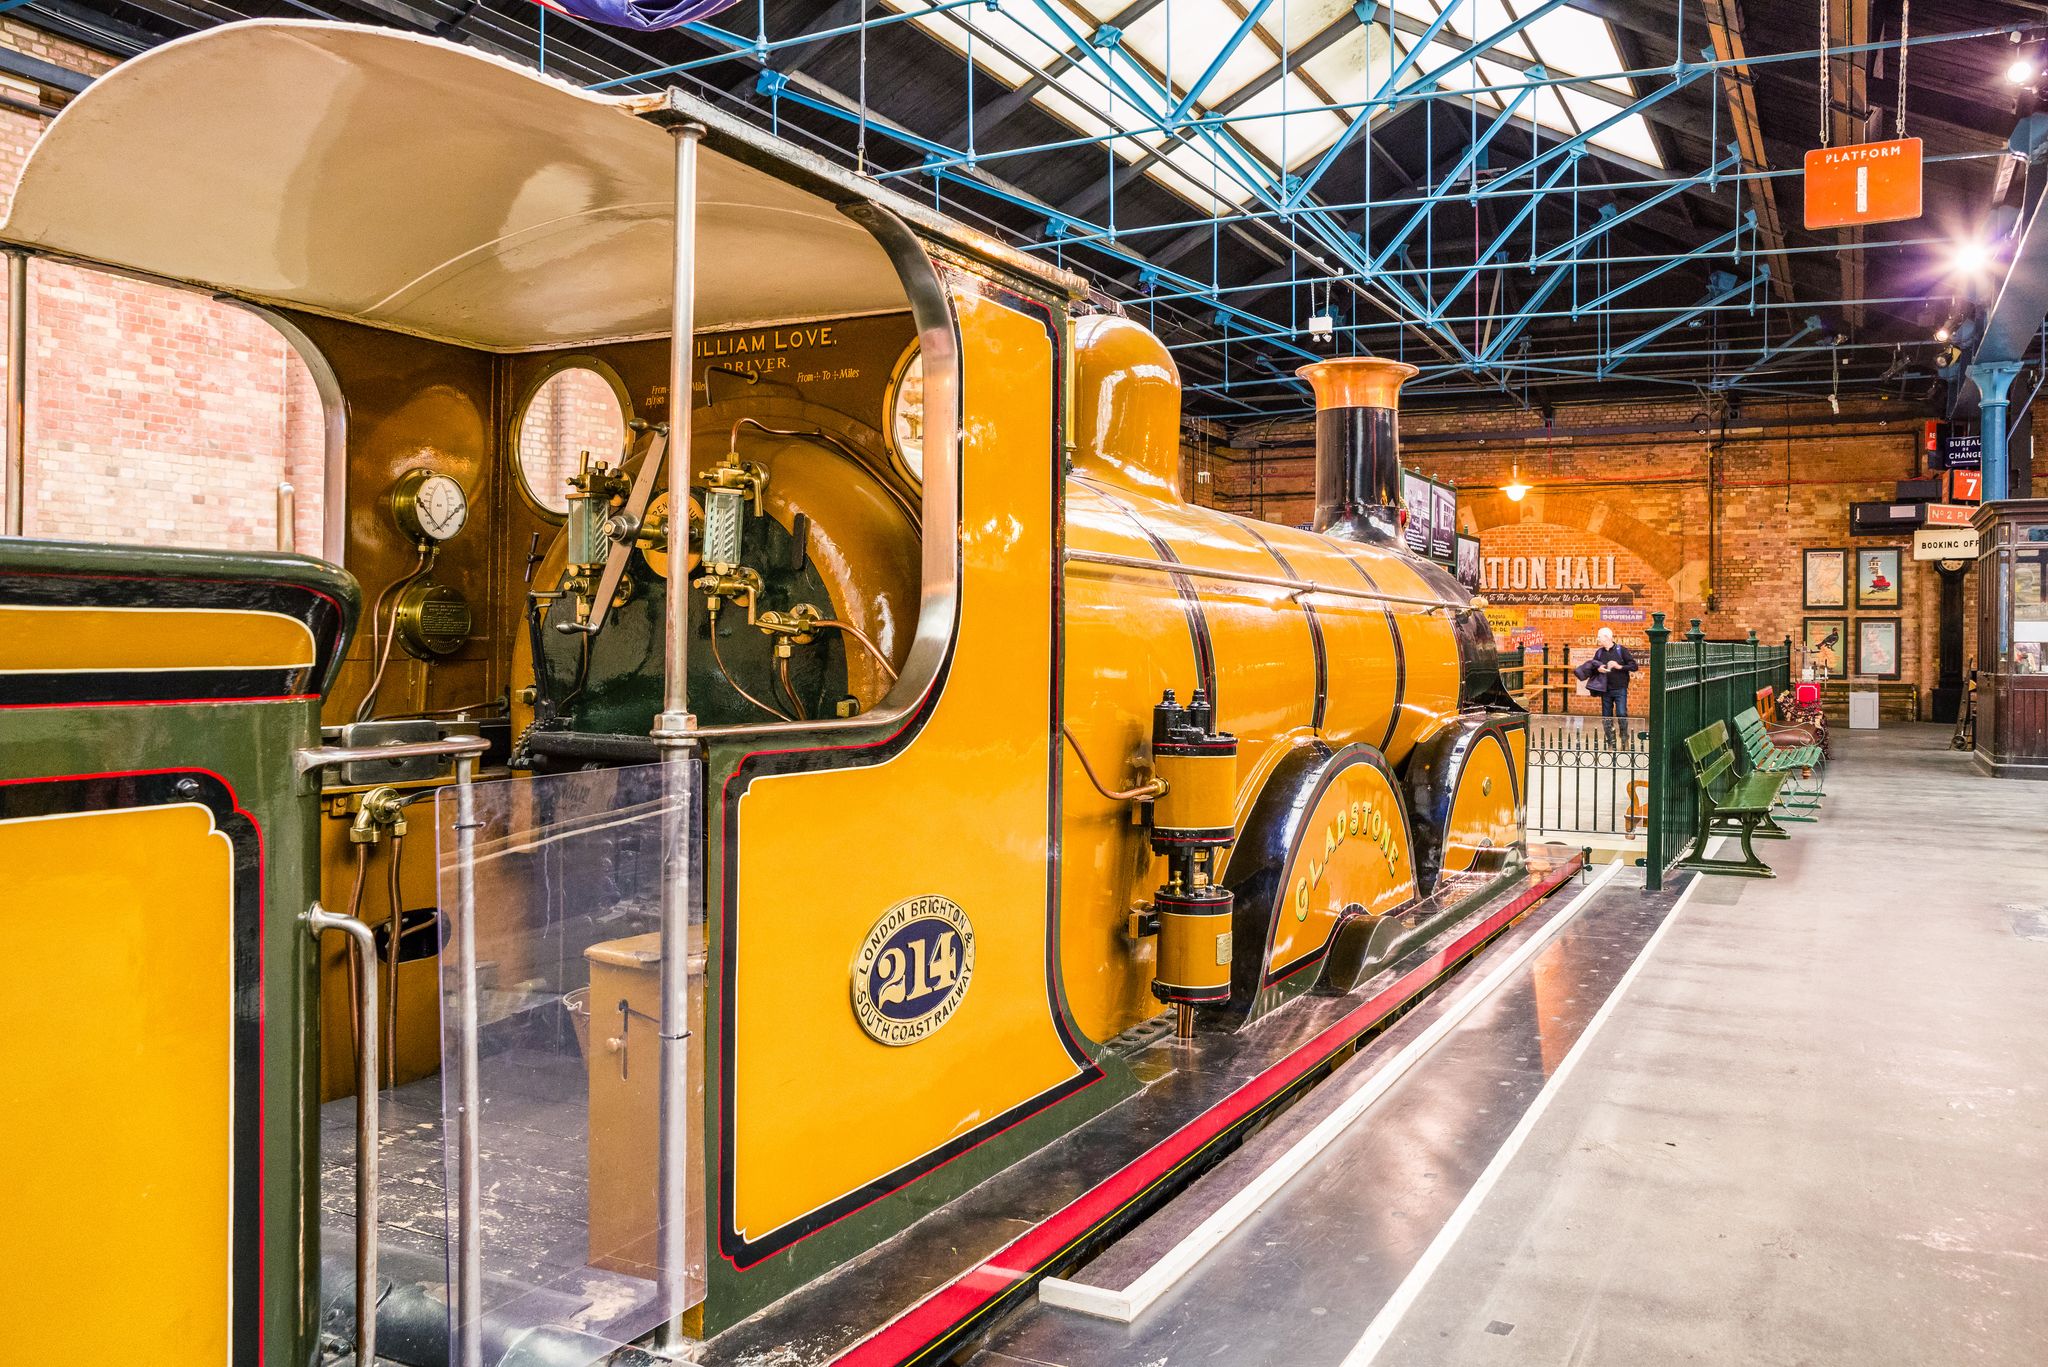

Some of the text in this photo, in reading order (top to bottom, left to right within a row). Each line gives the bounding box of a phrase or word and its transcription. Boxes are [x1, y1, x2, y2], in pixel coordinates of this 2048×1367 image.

[1825, 146, 1901, 163] PLATFORM
[1857, 166, 1868, 213] 1
[697, 335, 766, 357] ILLIAM
[797, 368, 860, 382] From To Miles
[1949, 439, 1982, 448] BUREAU
[1948, 451, 1981, 460] CHANGE
[1966, 478, 1978, 497] 7
[652, 502, 669, 517] PEN
[1946, 511, 1953, 520] 2
[1957, 511, 1970, 520] PL
[1921, 539, 1980, 550] BOOKING OFF
[1479, 554, 1622, 590] ATION HALL
[1508, 593, 1527, 603] People
[1540, 594, 1561, 604] Joined
[1562, 593, 1571, 602] Us
[1572, 593, 1581, 602] On
[1582, 593, 1595, 602] Our
[1594, 593, 1620, 604] Journey
[1511, 630, 1545, 645] NATIONAL
[1515, 638, 1544, 649] RILWAY
[1295, 801, 1399, 922] GLADSTONE
[858, 907, 906, 976] LONDON
[911, 899, 967, 931] BRIGHTON
[877, 930, 957, 1010] 214
[856, 962, 973, 1042] SOUTH COAST RAILWAY
